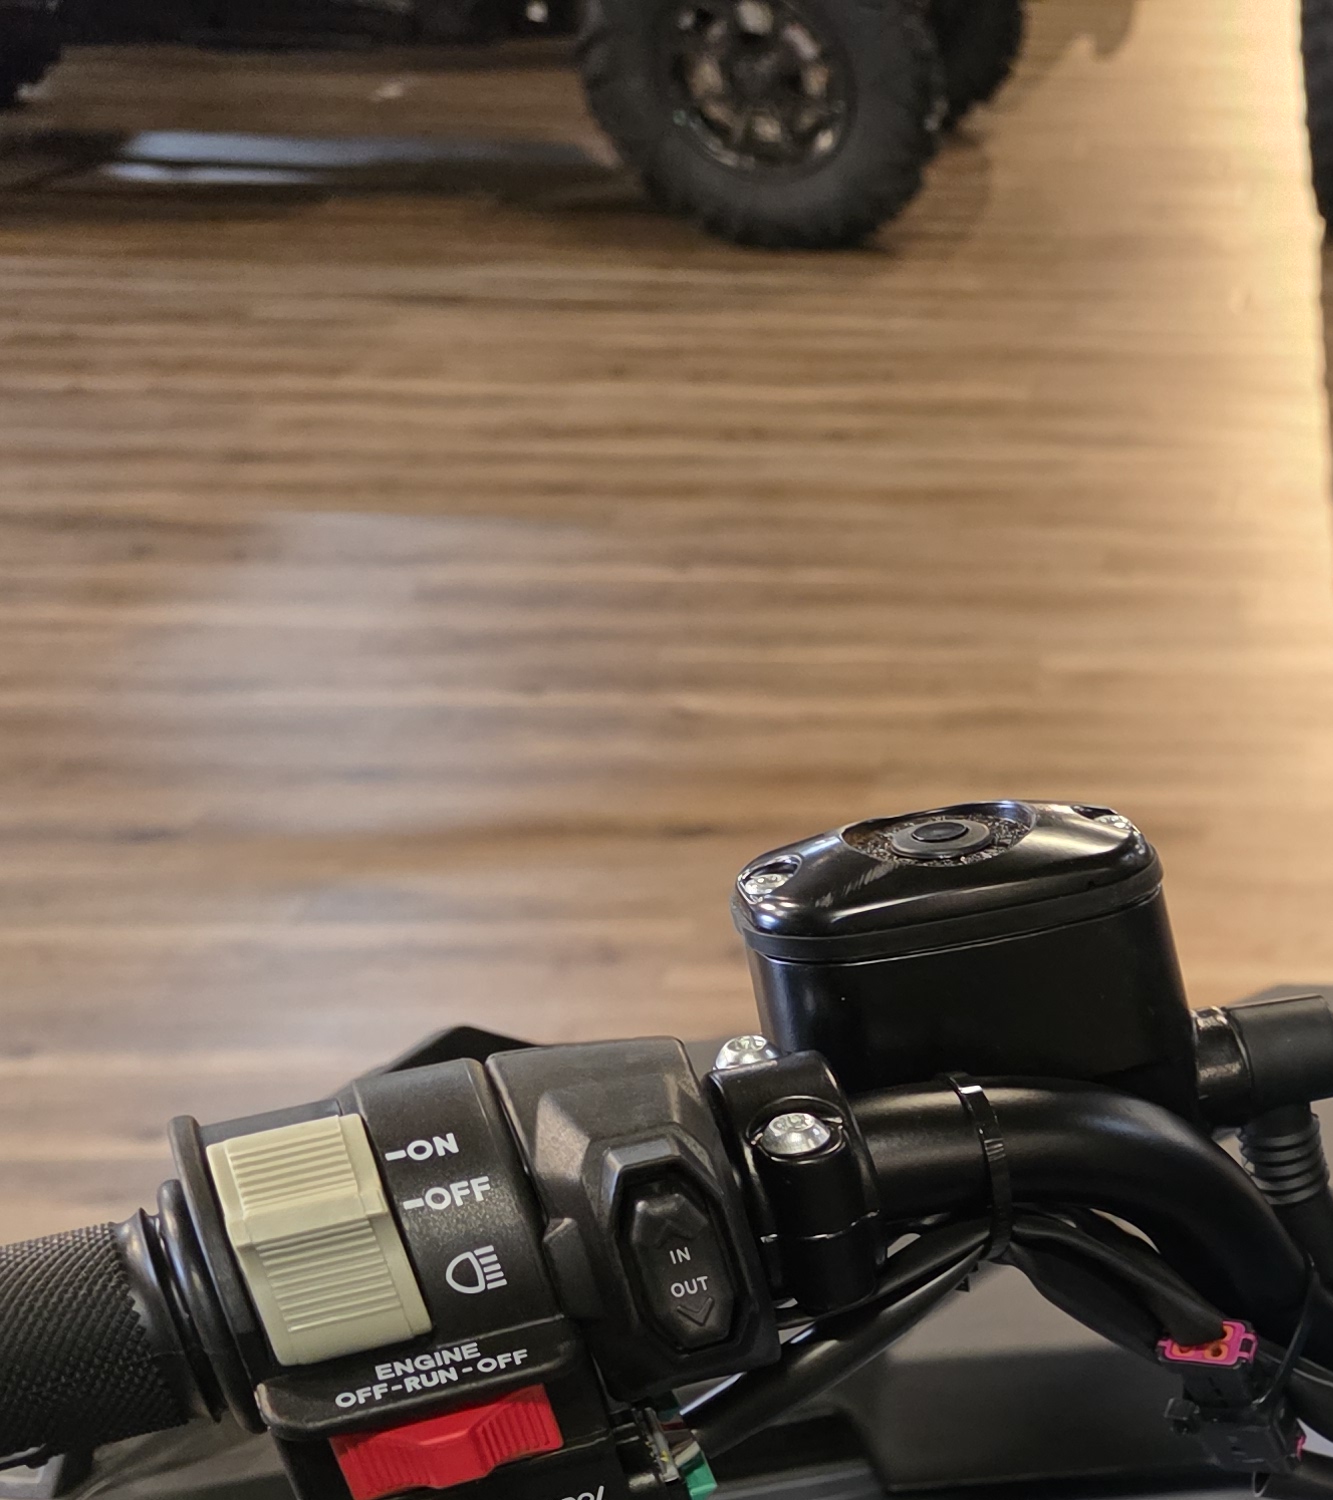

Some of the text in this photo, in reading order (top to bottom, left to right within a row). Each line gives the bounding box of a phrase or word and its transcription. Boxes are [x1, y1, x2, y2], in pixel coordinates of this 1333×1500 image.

[669, 1246, 691, 1265] IN
[670, 1275, 709, 1298] OUT
[375, 1343, 481, 1380] ENGINE
